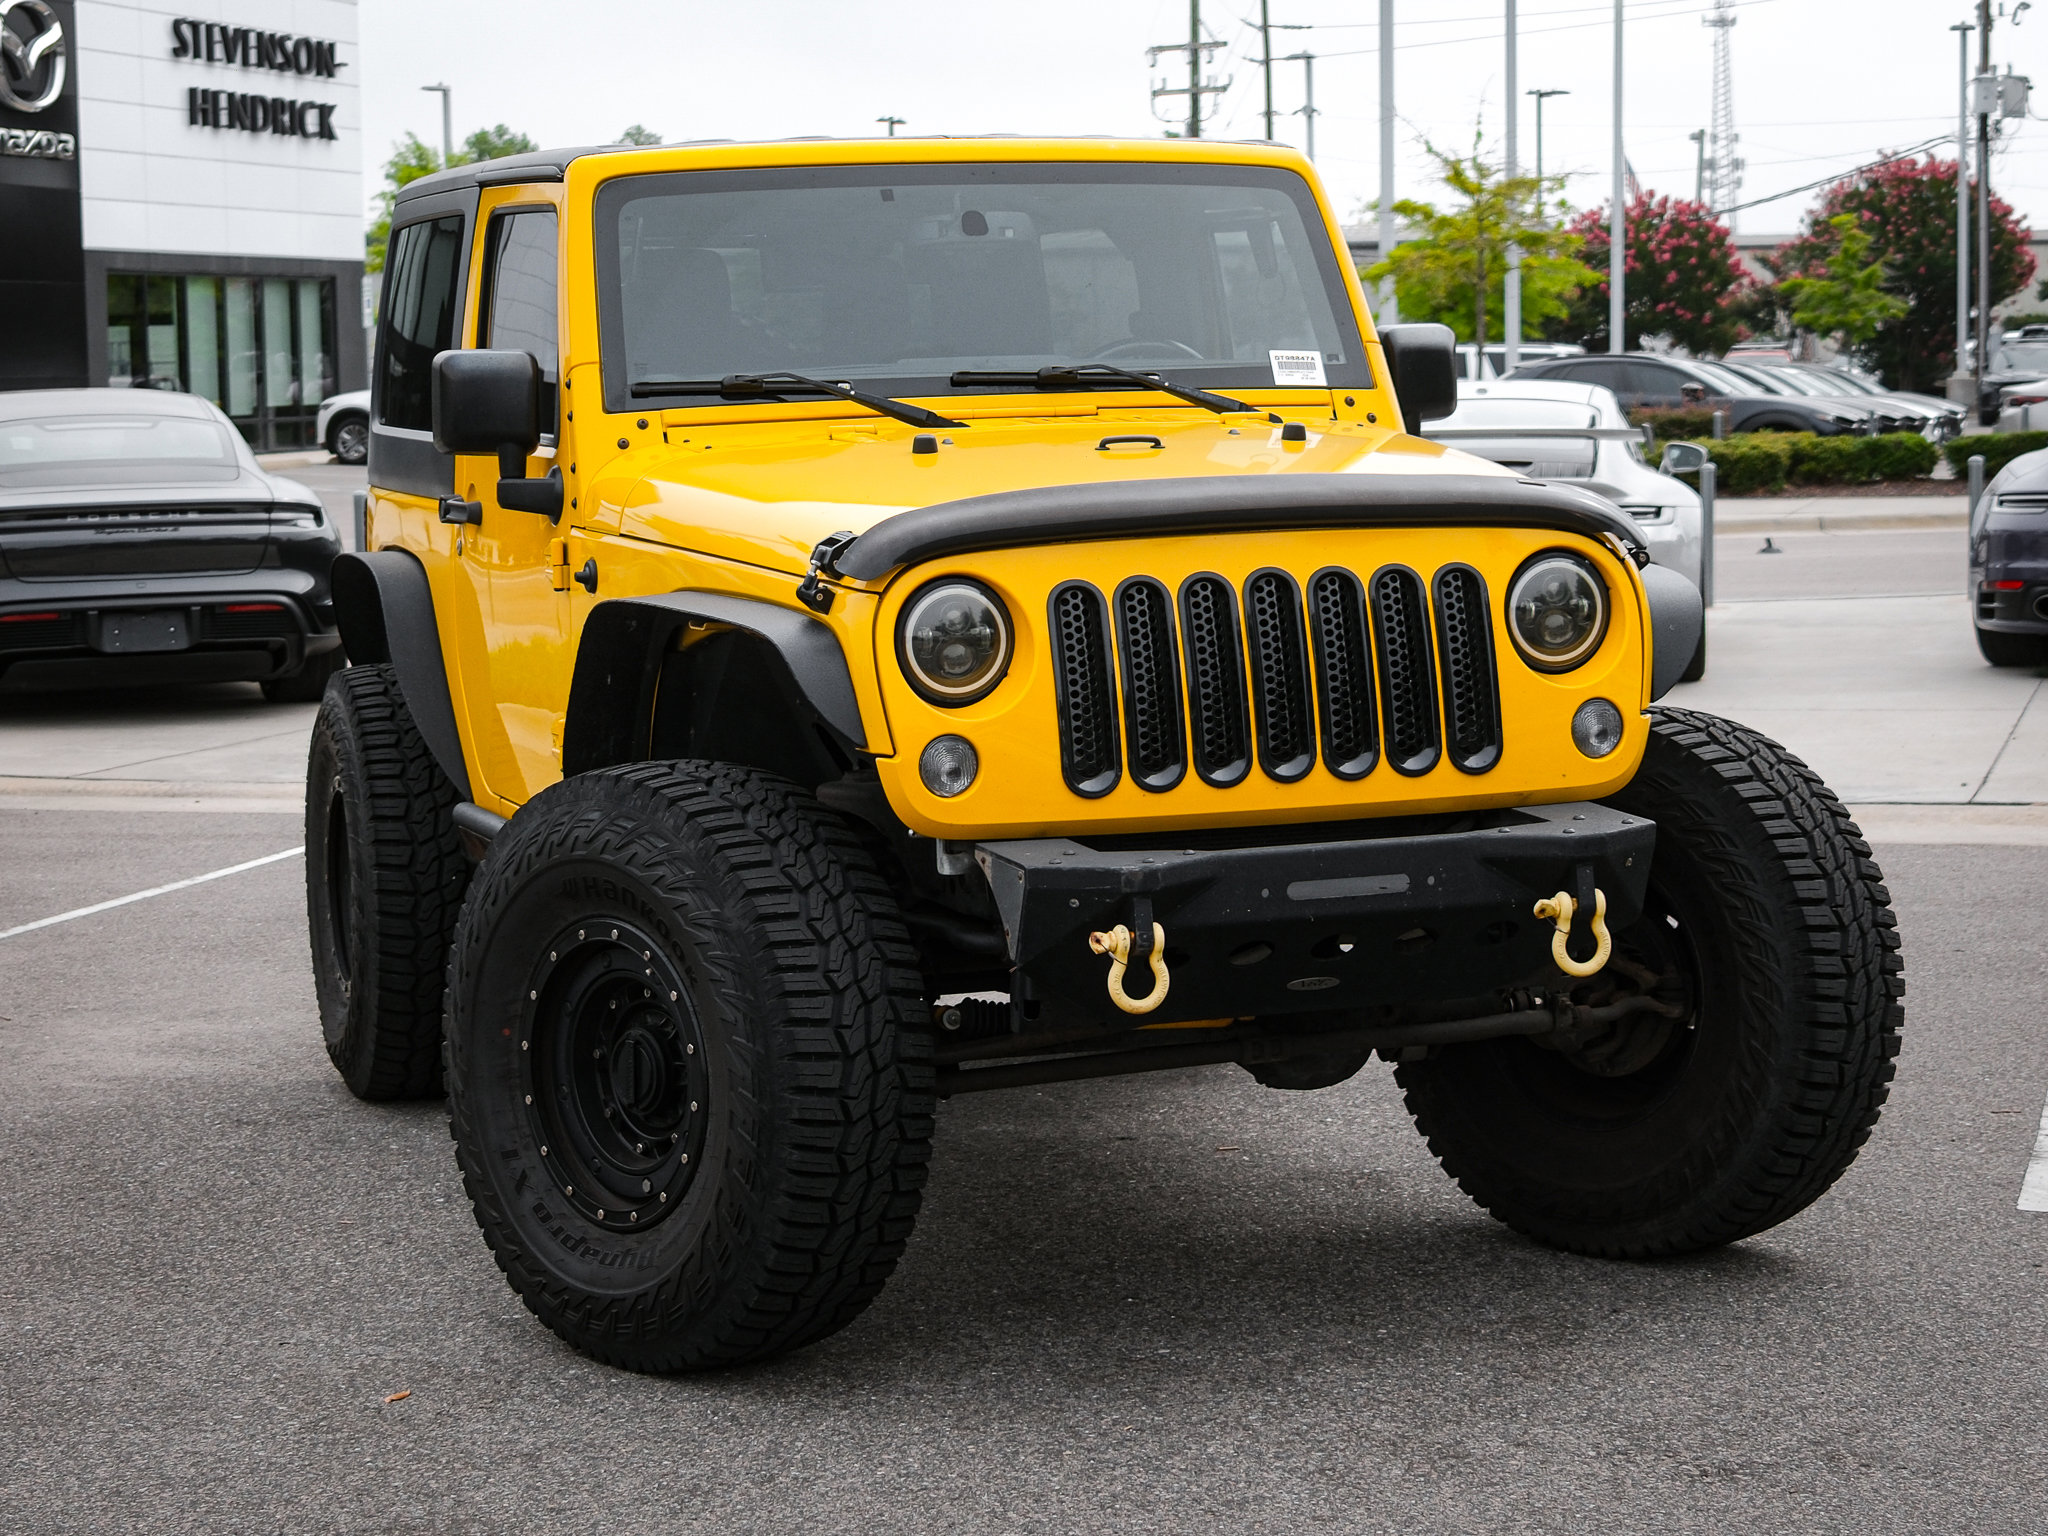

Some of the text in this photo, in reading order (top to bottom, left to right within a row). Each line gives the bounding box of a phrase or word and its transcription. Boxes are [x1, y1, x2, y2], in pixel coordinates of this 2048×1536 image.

[188, 87, 338, 140] HENDRICK
[67, 510, 200, 522] PORSCHE
[580, 875, 699, 989] Hankook
[532, 1202, 660, 1272] Dynapro
